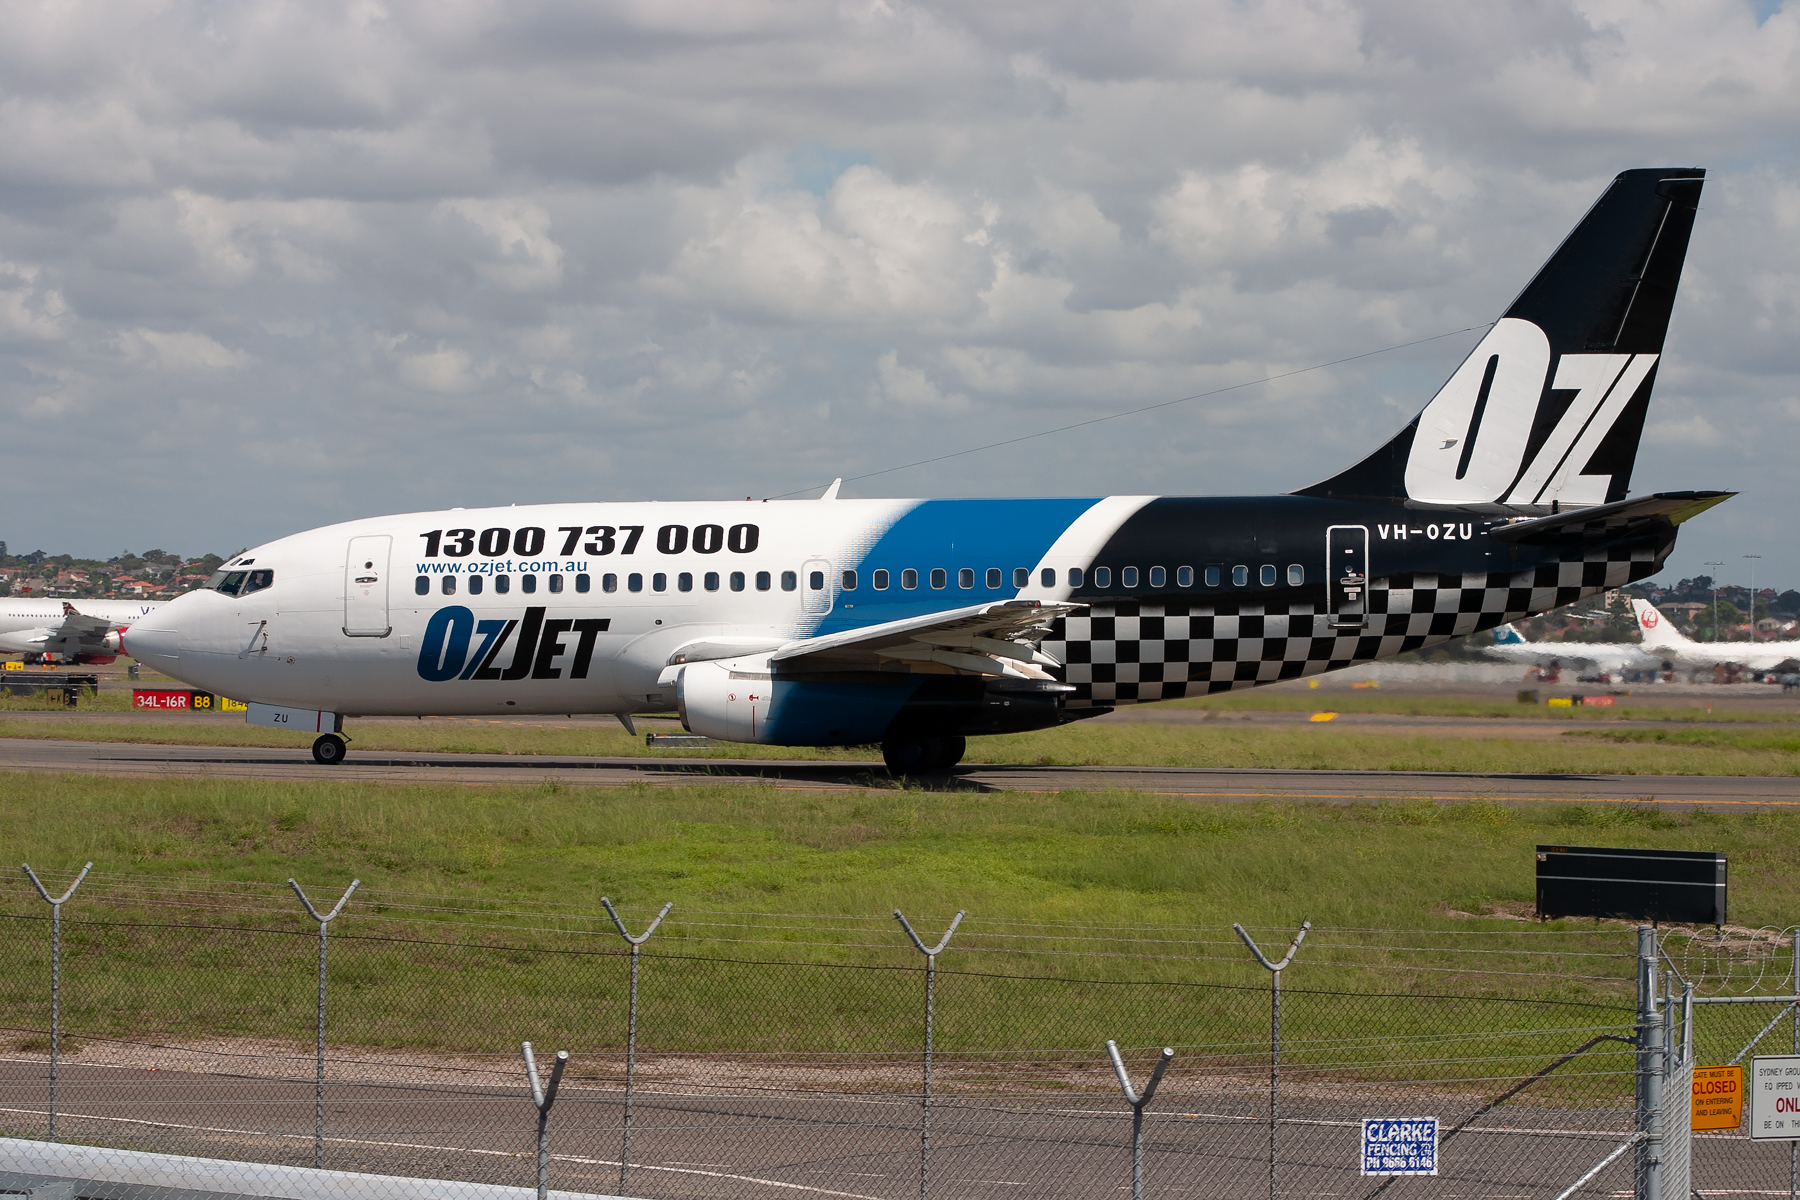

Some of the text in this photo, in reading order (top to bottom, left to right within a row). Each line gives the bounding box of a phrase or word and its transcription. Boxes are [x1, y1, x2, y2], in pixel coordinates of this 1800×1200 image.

[1404, 317, 1660, 505] OZ
[1377, 522, 1473, 540] VH-OZU
[420, 523, 760, 557] 1300 737 000
[416, 559, 588, 577] www.ozjet.com.au
[137, 695, 211, 708] 34L-16R B8
[273, 713, 289, 723] ZU
[1693, 1069, 1735, 1079] GATE MUST BE
[1759, 1067, 1783, 1077] SYDNEY
[1692, 1080, 1737, 1095] CLOSED
[1695, 1097, 1733, 1106] ON ENTERING
[1709, 1108, 1733, 1116] LEAVING
[1764, 1120, 1772, 1129] BE
[1775, 1120, 1784, 1129] ON
[1367, 1123, 1434, 1142] CLARKE
[1368, 1144, 1418, 1156] FENCING
[1366, 1157, 1380, 1168] PH
